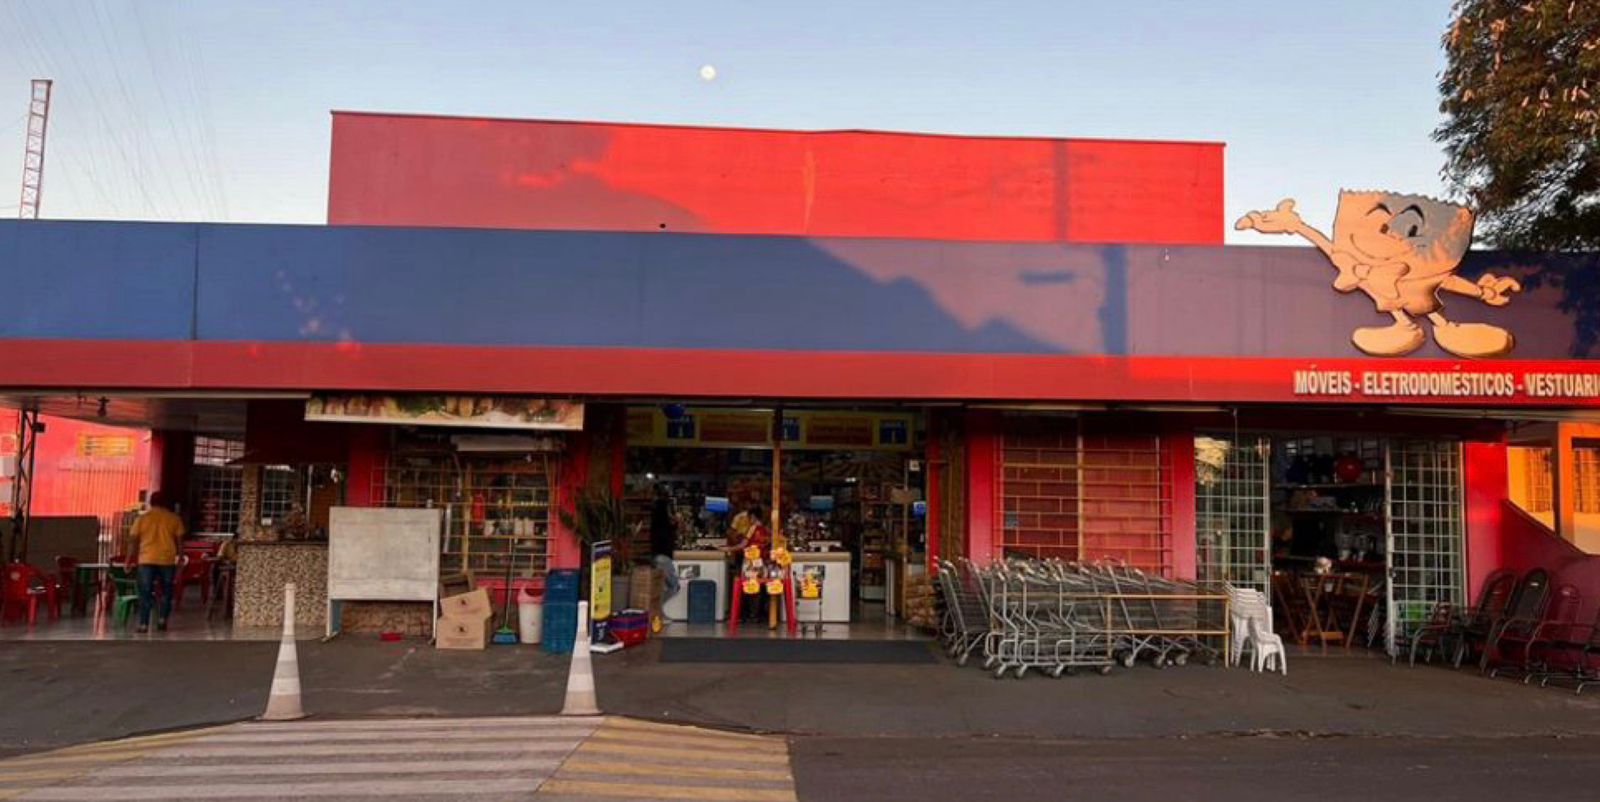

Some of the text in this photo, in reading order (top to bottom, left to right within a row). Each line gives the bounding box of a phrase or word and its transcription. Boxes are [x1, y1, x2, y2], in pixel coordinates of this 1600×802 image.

[1294, 364, 1352, 395] MÓVEIS
[1363, 364, 1515, 396] ELETRODOMÉSTICOS
[1525, 373, 1600, 397] VESTUARI
